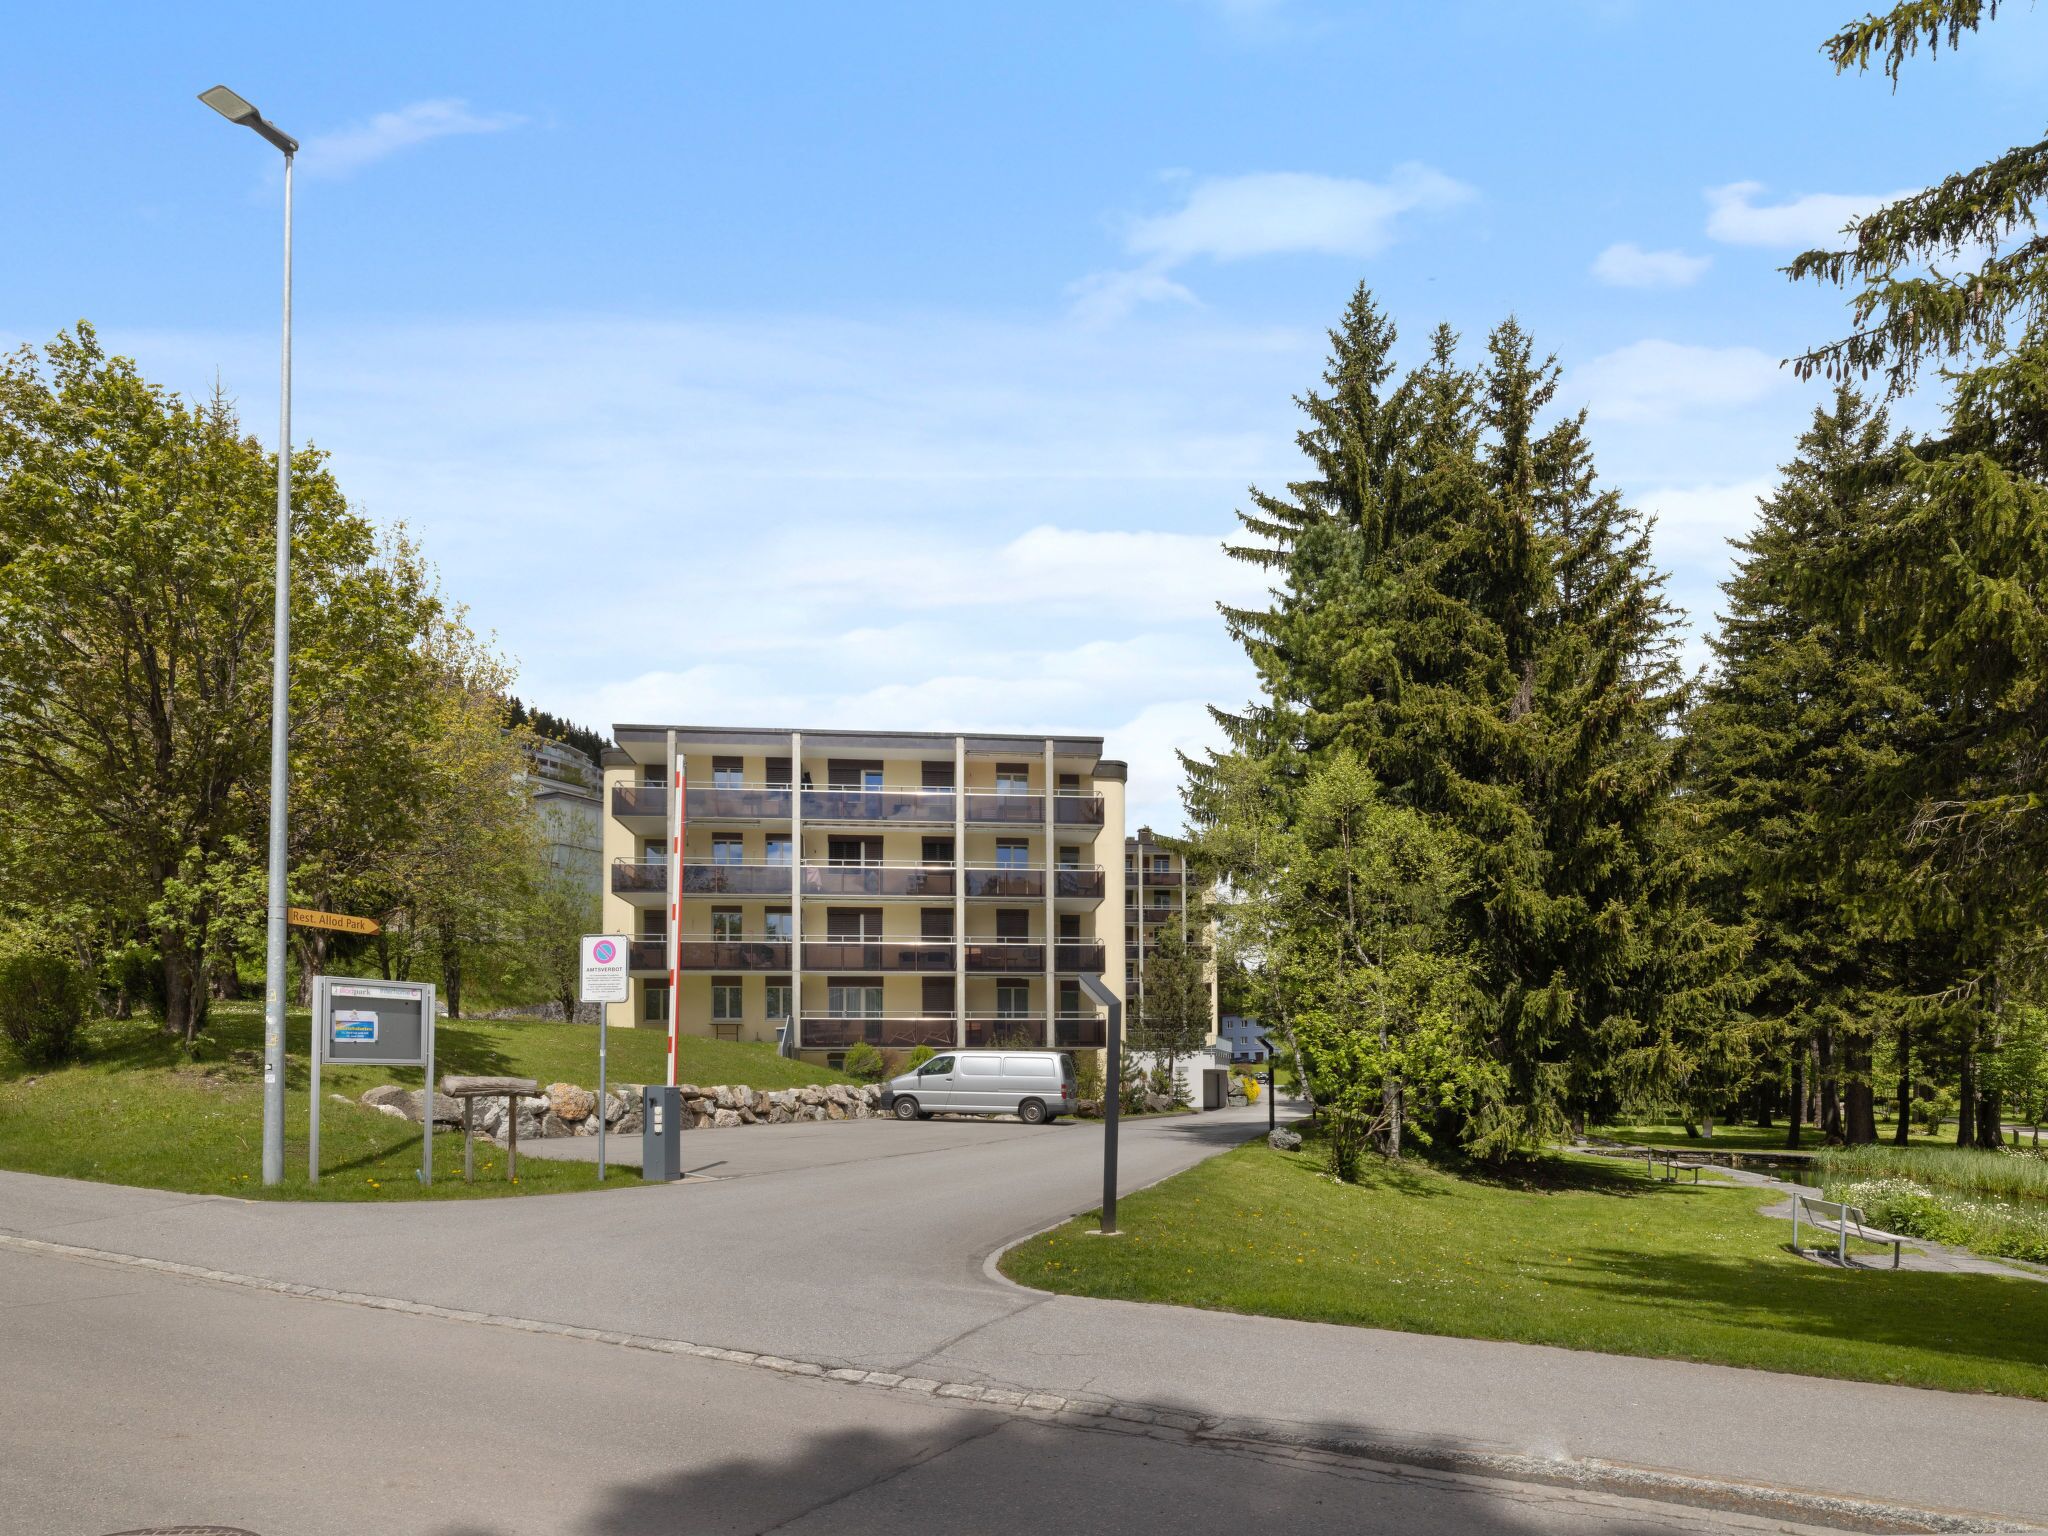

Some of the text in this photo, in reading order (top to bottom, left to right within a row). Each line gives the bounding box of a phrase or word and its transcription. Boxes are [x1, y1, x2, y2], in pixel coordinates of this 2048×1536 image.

[293, 911, 365, 930] Rest. Allod Park
